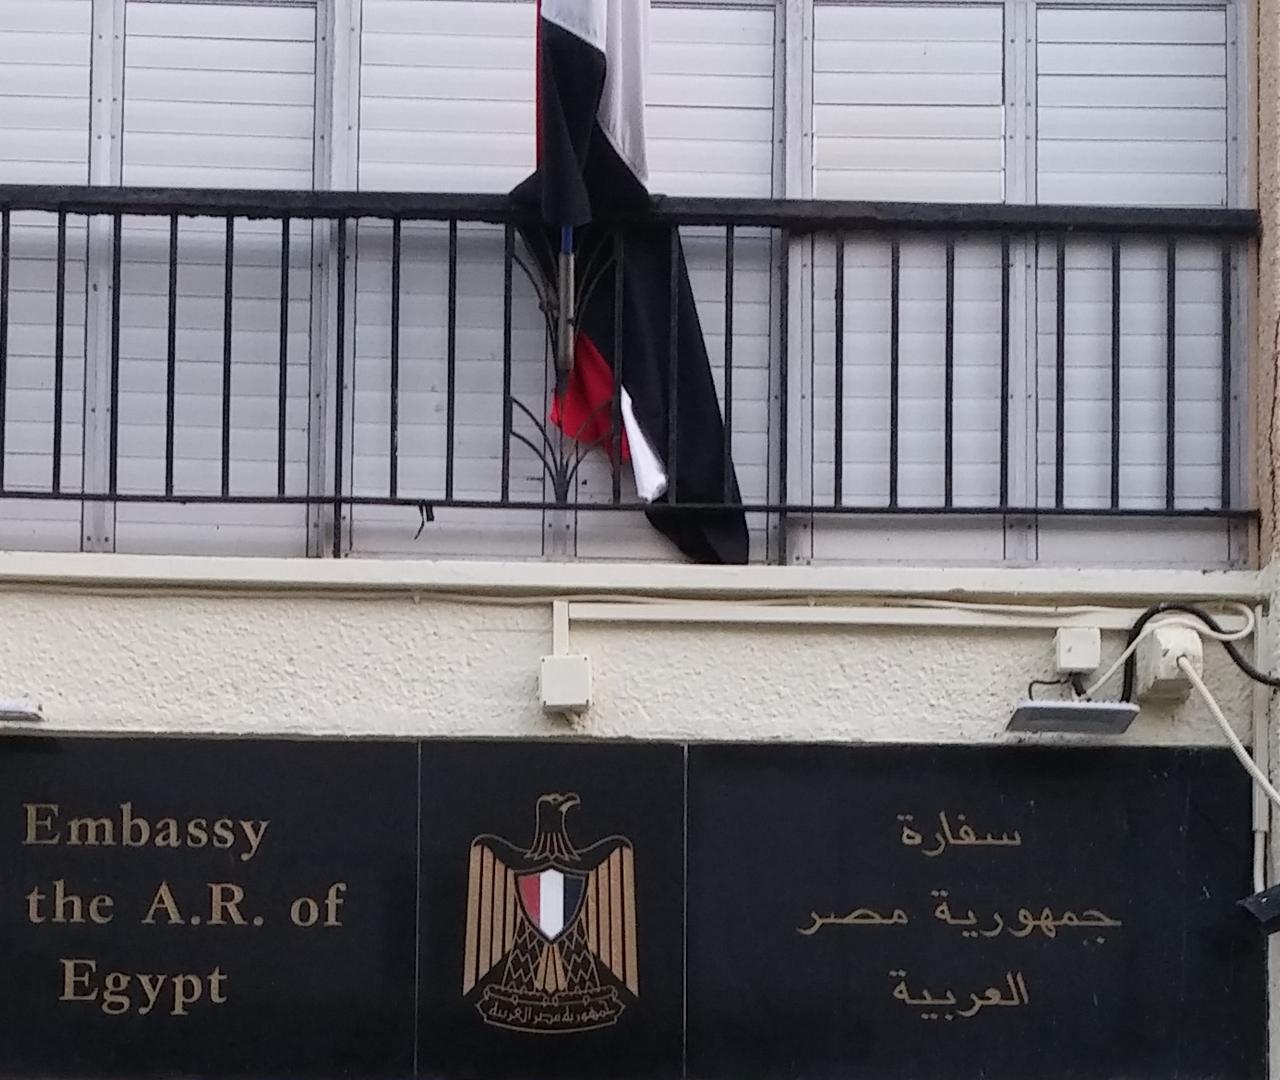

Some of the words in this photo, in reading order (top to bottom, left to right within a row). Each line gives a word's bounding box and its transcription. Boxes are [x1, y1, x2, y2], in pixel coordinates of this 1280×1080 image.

[22, 803, 270, 861] Embassy
[896, 811, 1021, 856] سفارة
[26, 880, 114, 925] the
[142, 881, 264, 926] A.R.
[290, 882, 347, 927] of
[796, 907, 909, 935] مصر
[931, 889, 1122, 943] جمهورية
[60, 958, 228, 1015] Egypt
[888, 969, 1030, 1020] العربية
